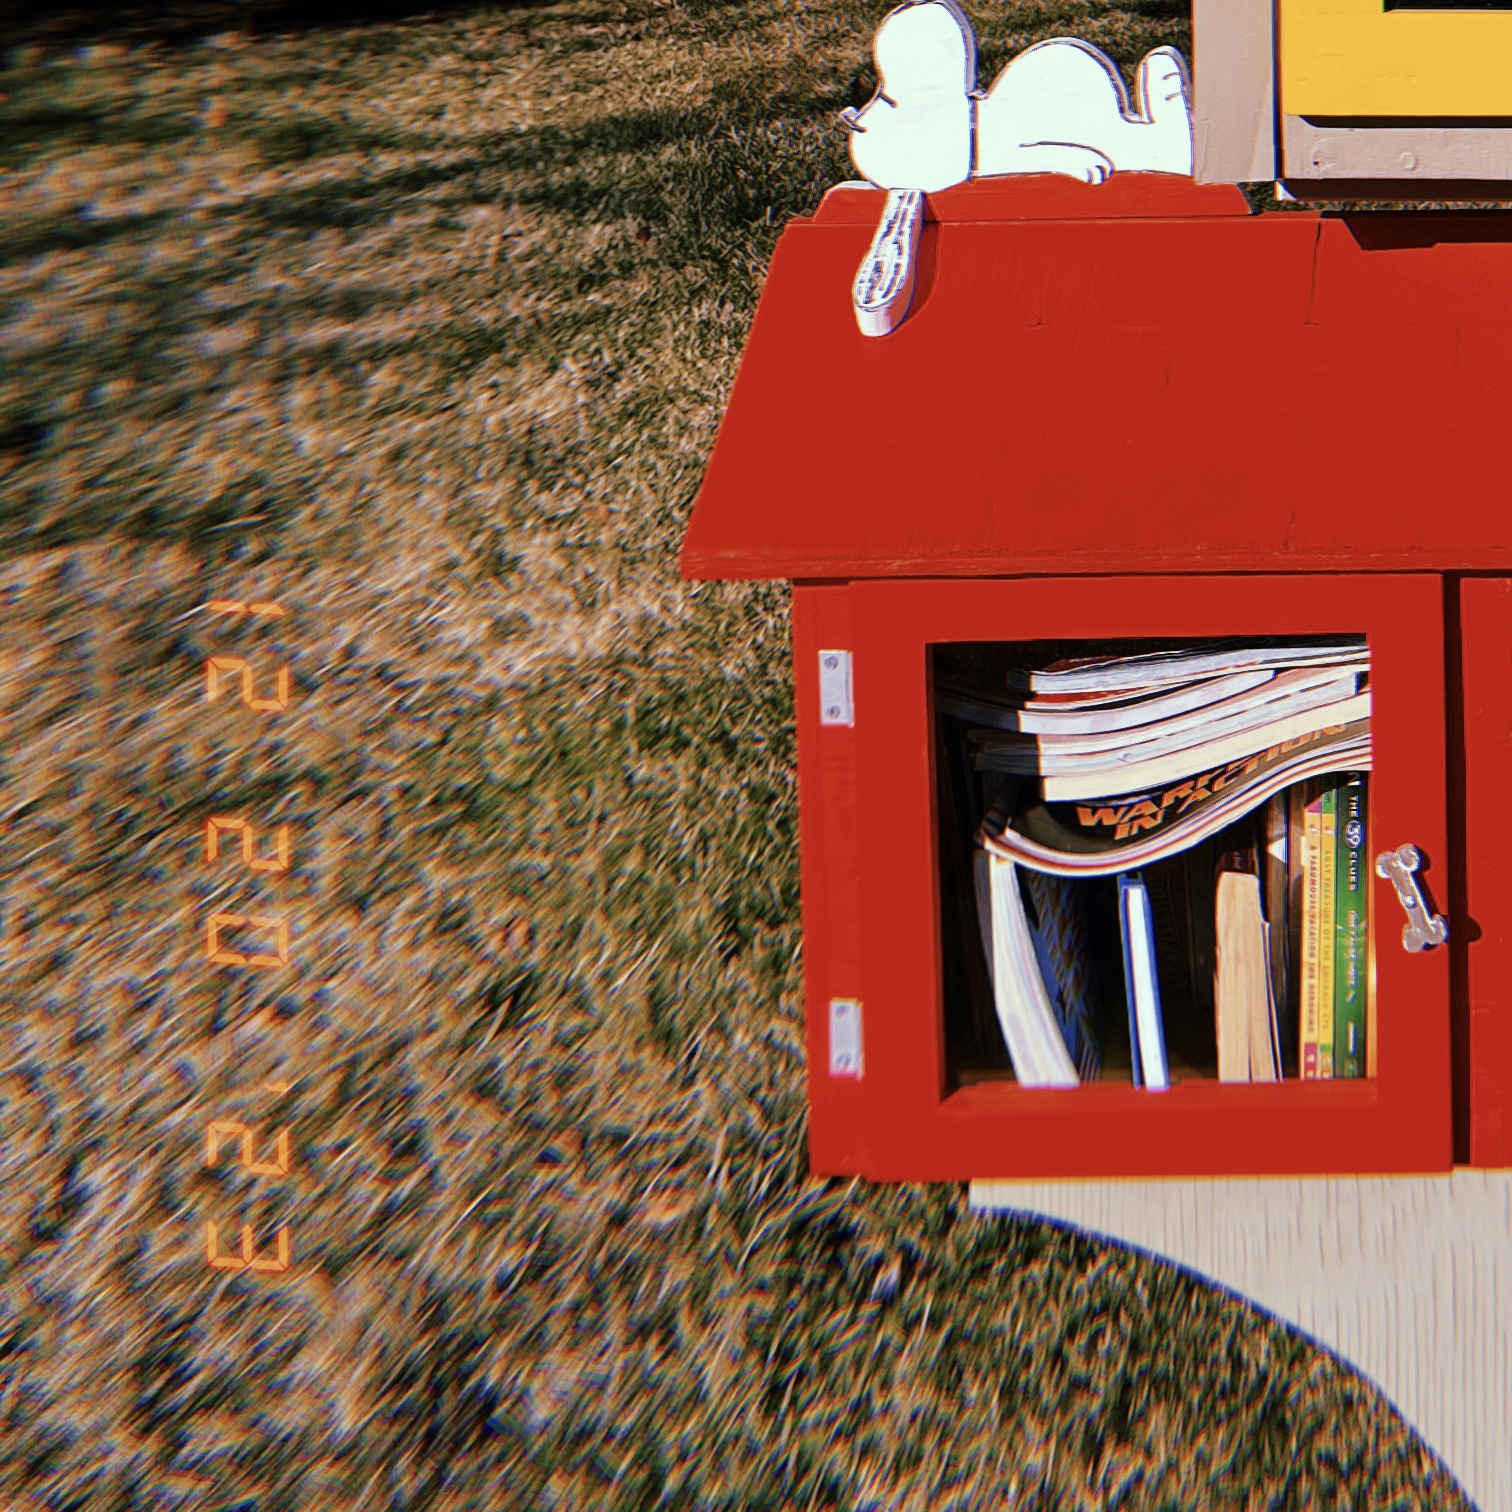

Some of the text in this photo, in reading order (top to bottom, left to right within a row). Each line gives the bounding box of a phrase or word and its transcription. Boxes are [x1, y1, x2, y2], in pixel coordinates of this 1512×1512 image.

[1176, 723, 1350, 814] ACTION
[1348, 794, 1361, 818] THE
[1113, 809, 1165, 841] IN
[1347, 822, 1362, 846] 39
[1347, 851, 1359, 892] CLUES
